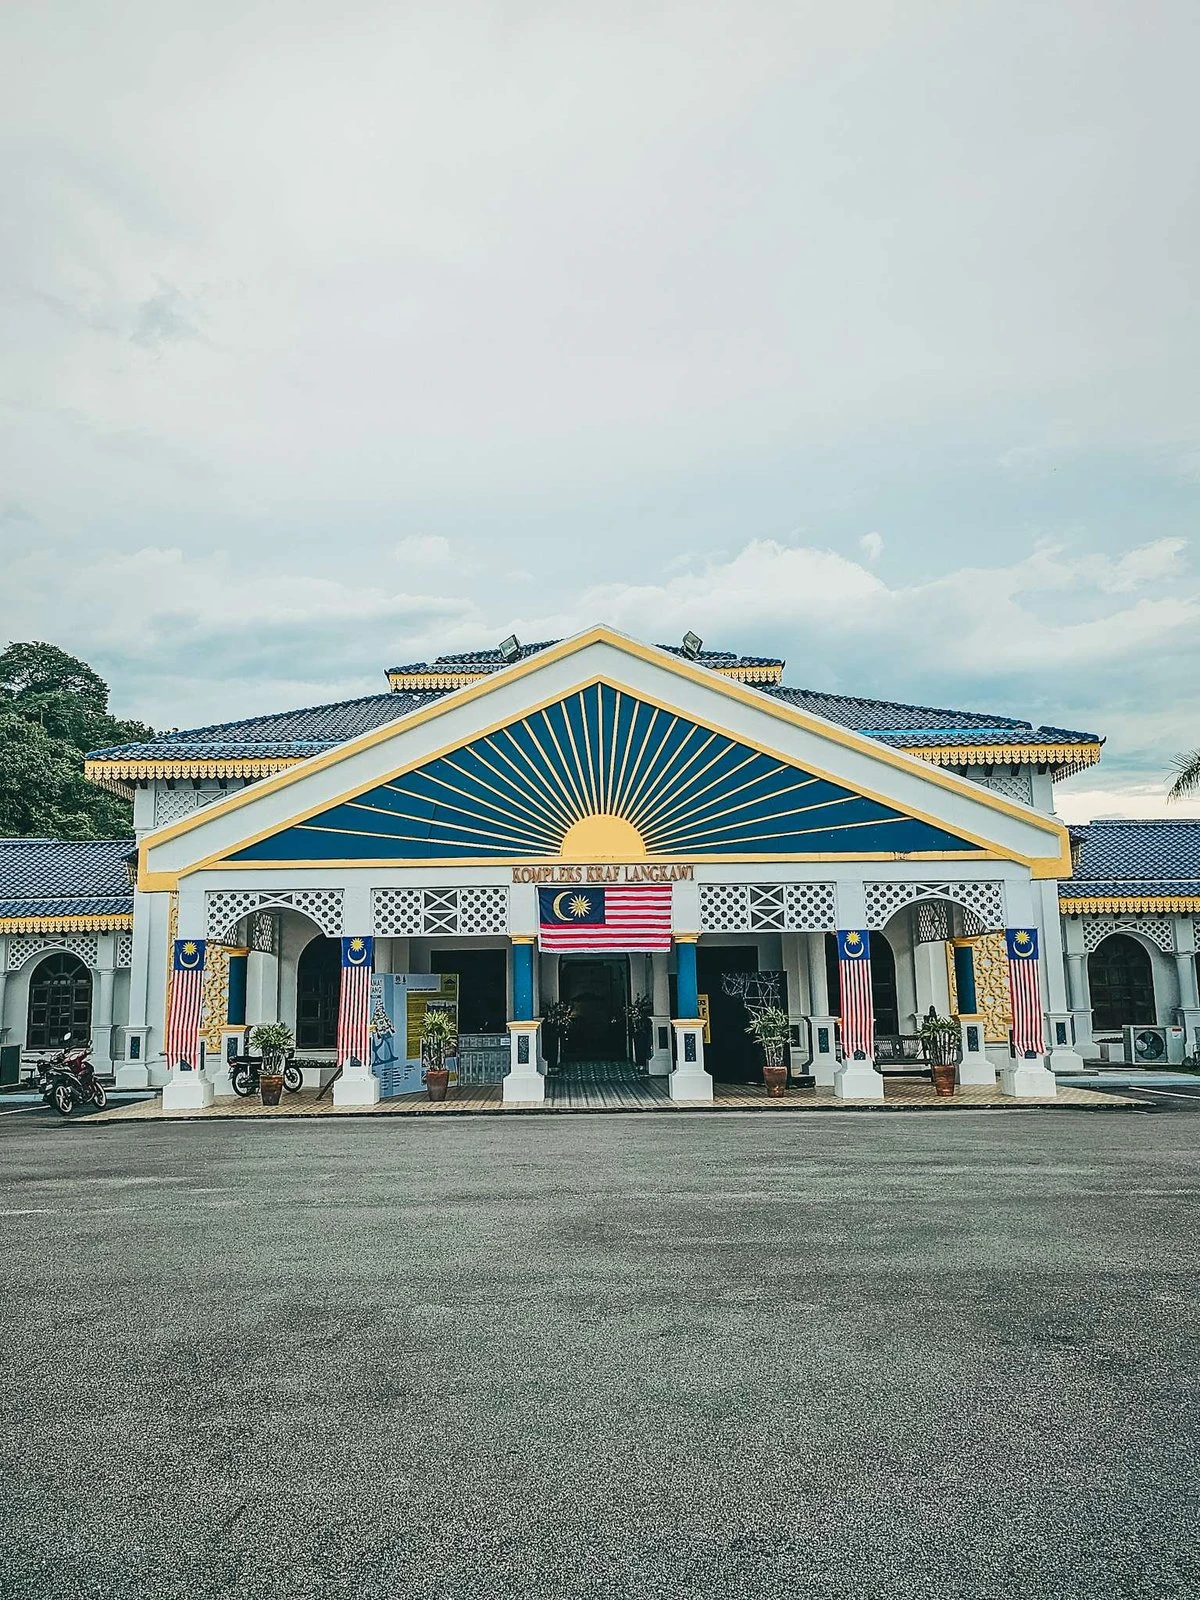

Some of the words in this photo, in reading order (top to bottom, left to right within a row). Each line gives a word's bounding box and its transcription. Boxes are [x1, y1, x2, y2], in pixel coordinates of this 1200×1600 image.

[511, 867, 582, 883] KOMPLEKS
[586, 866, 620, 882] KRAF
[624, 865, 694, 882] LANGKAWI
